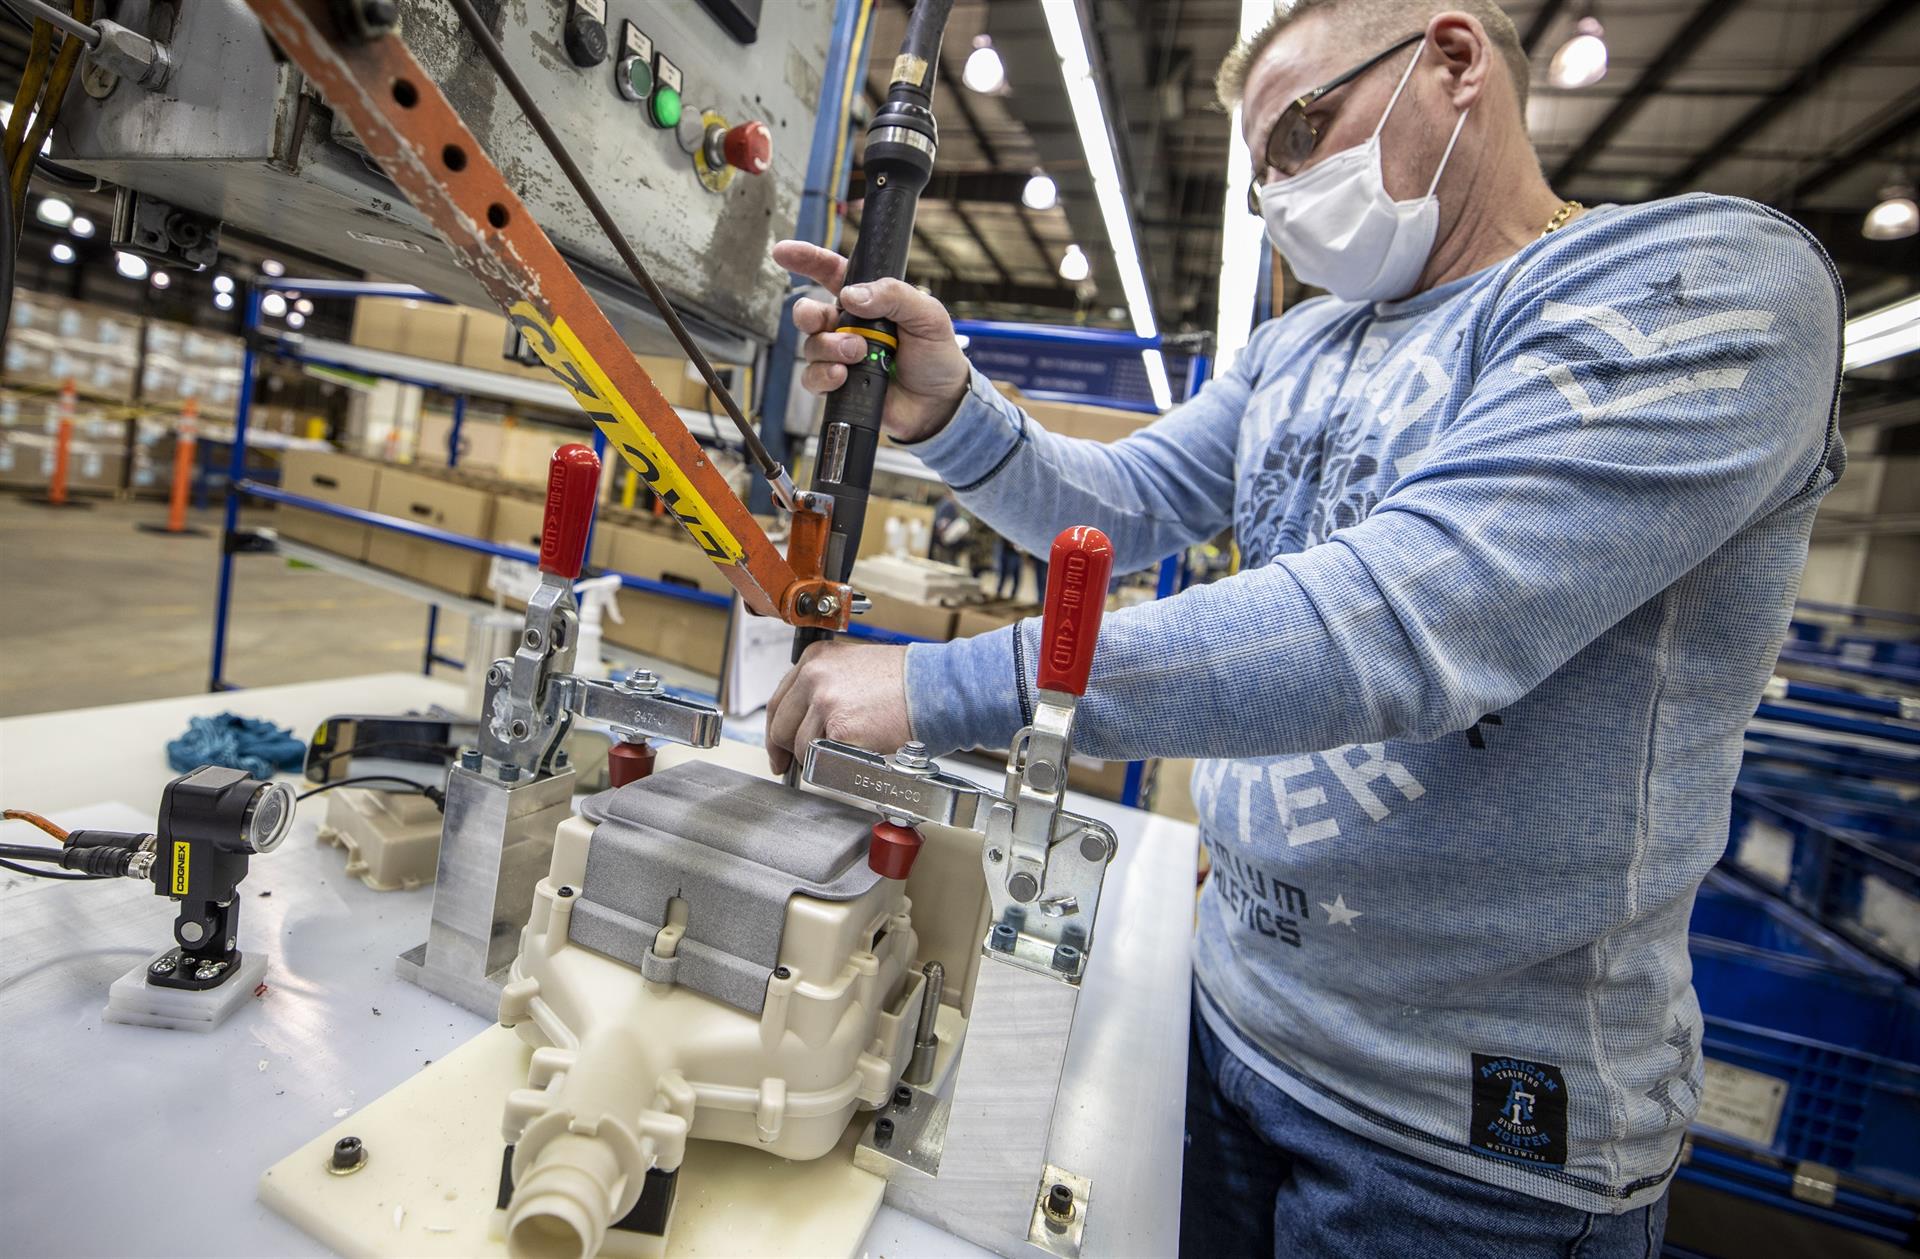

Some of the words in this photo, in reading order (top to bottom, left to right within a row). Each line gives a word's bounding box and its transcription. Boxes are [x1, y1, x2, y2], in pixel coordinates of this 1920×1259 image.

[854, 774, 921, 803] DE-STA-CO
[176, 844, 186, 892] COGNEX
[1480, 1059, 1559, 1093] AMERICAN
[1496, 1069, 1539, 1088] TRAINING
[1487, 1120, 1552, 1148] FIGHTER
[1497, 1117, 1537, 1136] DIVISION
[1486, 1141, 1546, 1161] WORLDWIDE
